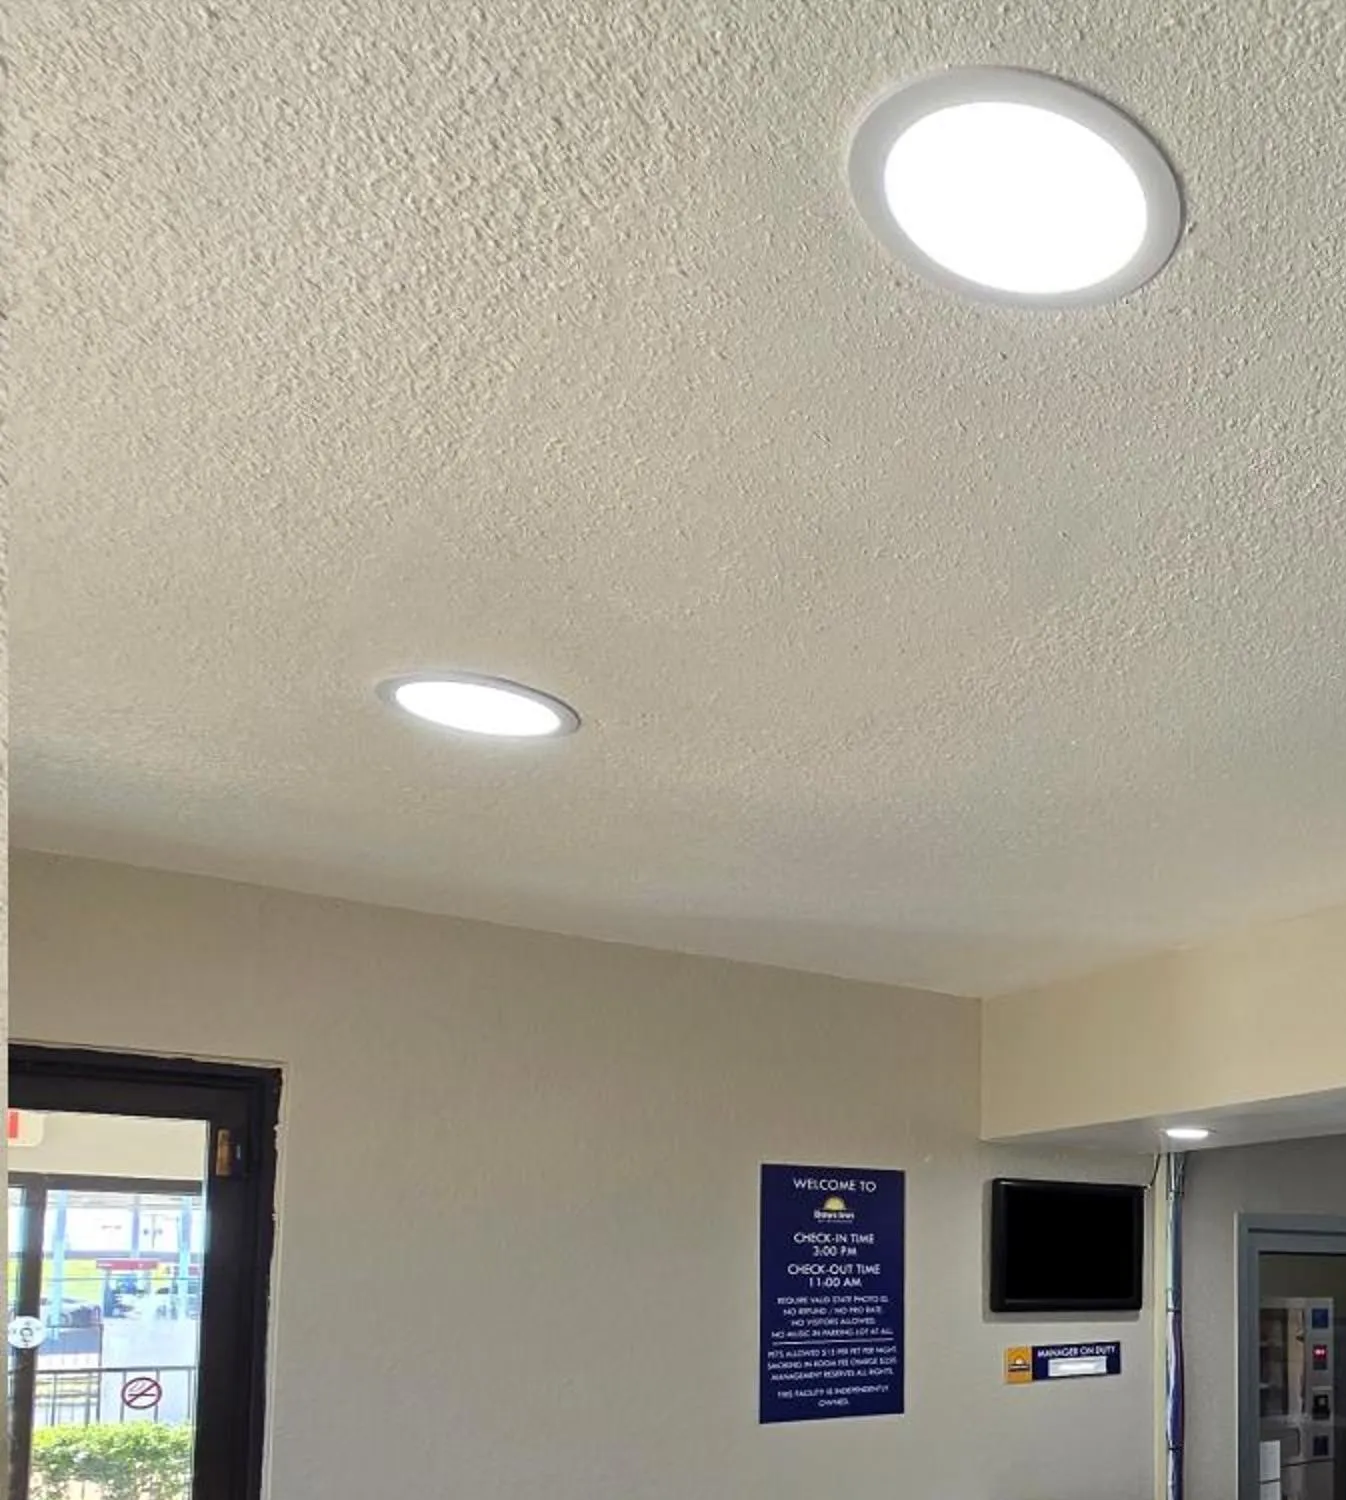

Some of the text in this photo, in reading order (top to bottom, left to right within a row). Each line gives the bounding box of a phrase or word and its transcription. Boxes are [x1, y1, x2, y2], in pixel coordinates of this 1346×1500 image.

[793, 1178, 877, 1192] WELCOME TO
[793, 1233, 875, 1244] CHECK-IN TIME
[812, 1245, 858, 1257] 3:00 PM
[787, 1263, 881, 1275] CHECK-OUT TIME
[808, 1277, 862, 1288] 11:00 AM
[1037, 1345, 1116, 1358] MANAGER ON DUTY
